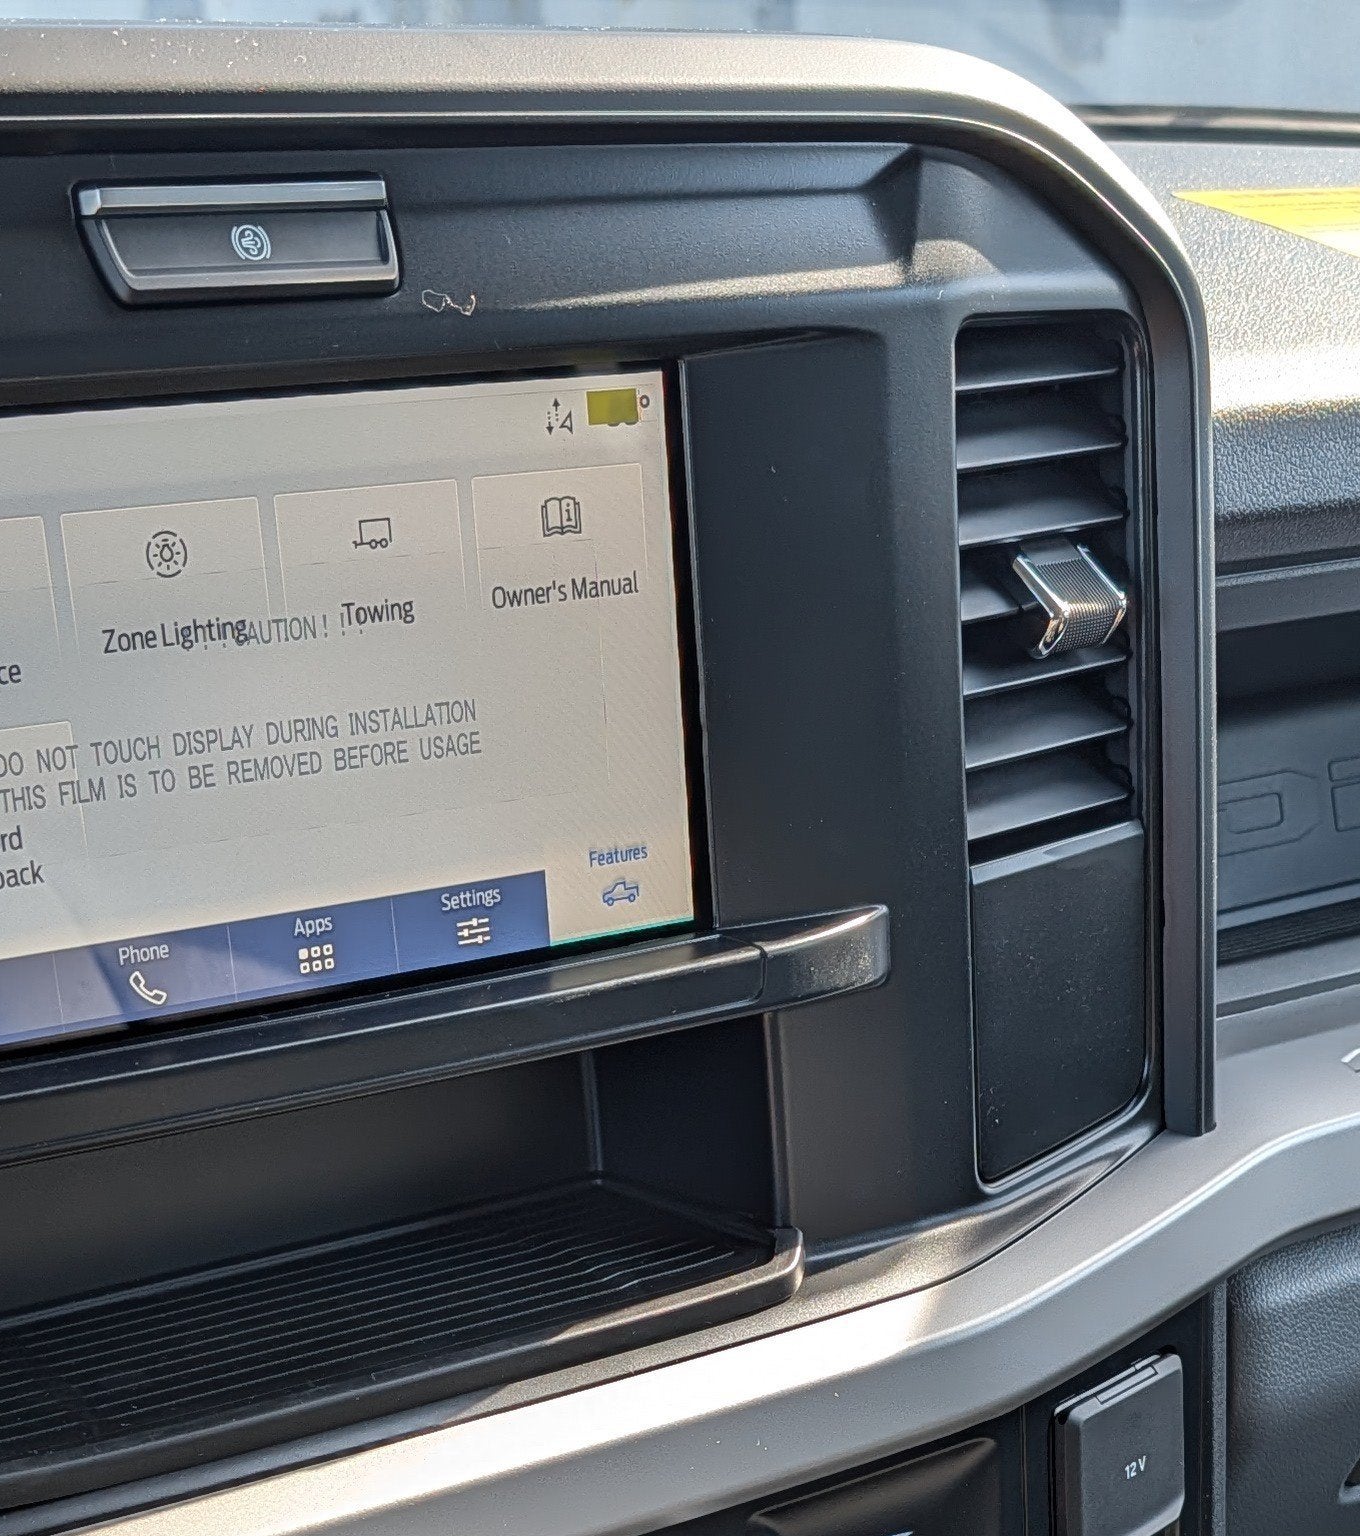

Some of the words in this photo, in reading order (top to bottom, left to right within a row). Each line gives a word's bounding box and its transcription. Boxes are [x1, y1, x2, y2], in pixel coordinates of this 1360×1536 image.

[492, 580, 568, 609] Owner's
[571, 570, 639, 600] Manual
[341, 598, 415, 627] Towing
[102, 628, 158, 654] Zone
[161, 617, 247, 651] Lighting
[235, 614, 317, 646] AUTION
[36, 745, 78, 773] NOT
[90, 735, 161, 766] TOUCH
[173, 724, 254, 756] DISPLAY
[266, 714, 339, 745] DURING
[349, 699, 476, 736] INSTALLATION
[0, 784, 47, 813] THIS
[59, 776, 106, 806] FILM
[119, 773, 137, 799] IS
[149, 768, 176, 794] TO
[188, 764, 215, 789] BE
[227, 751, 322, 785] REMOVED
[334, 740, 409, 771] BEFORE
[420, 731, 482, 760] USAGE
[589, 845, 648, 867] Features
[441, 887, 501, 911] Settings
[294, 917, 332, 937] Apps
[119, 943, 169, 966] Phone
